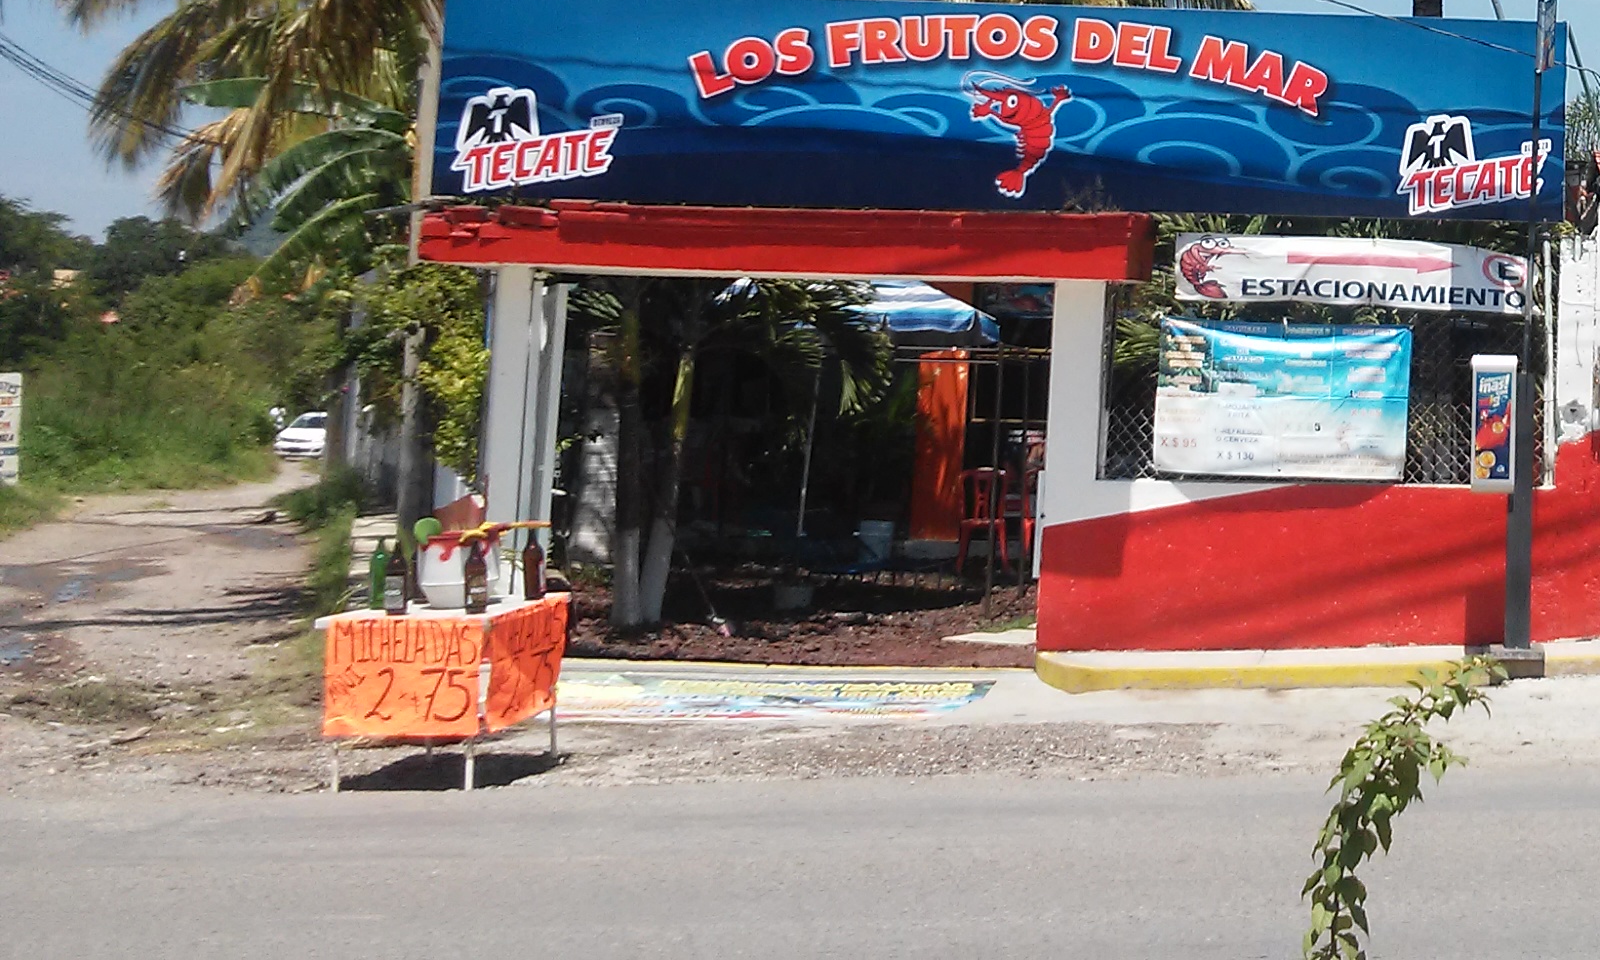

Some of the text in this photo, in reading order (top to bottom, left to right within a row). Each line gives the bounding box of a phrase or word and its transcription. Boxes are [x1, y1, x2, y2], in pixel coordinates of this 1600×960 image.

[688, 14, 1328, 117] LOS FRUTOS DEL MAR
[461, 126, 615, 187] TECATE
[1406, 153, 1545, 209] TECATE
[1240, 277, 1527, 309] ESTACIONAMIENTO
[334, 619, 478, 666] MICHELADAS
[364, 666, 394, 721] 2
